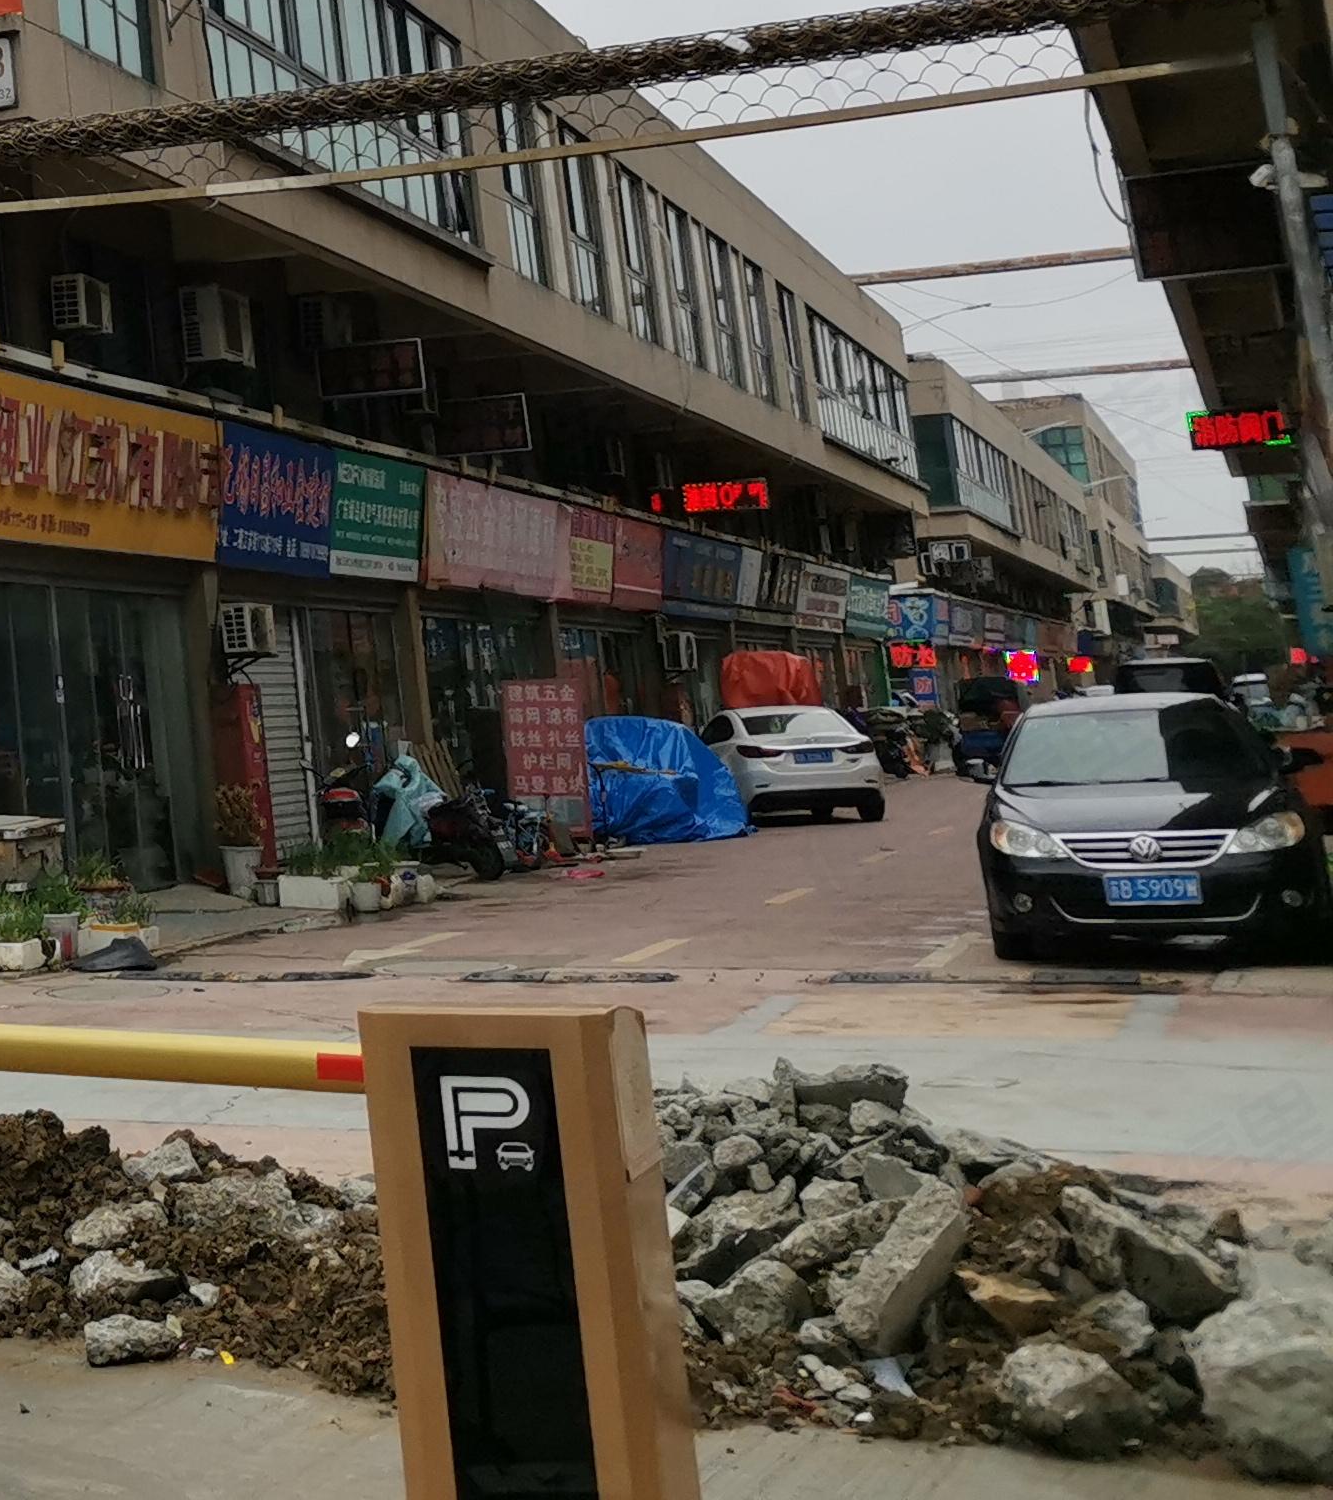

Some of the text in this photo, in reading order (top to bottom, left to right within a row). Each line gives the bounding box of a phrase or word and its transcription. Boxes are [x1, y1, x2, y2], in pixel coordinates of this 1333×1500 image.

[508, 684, 575, 701] 建筑五金
[440, 1075, 531, 1170] P
